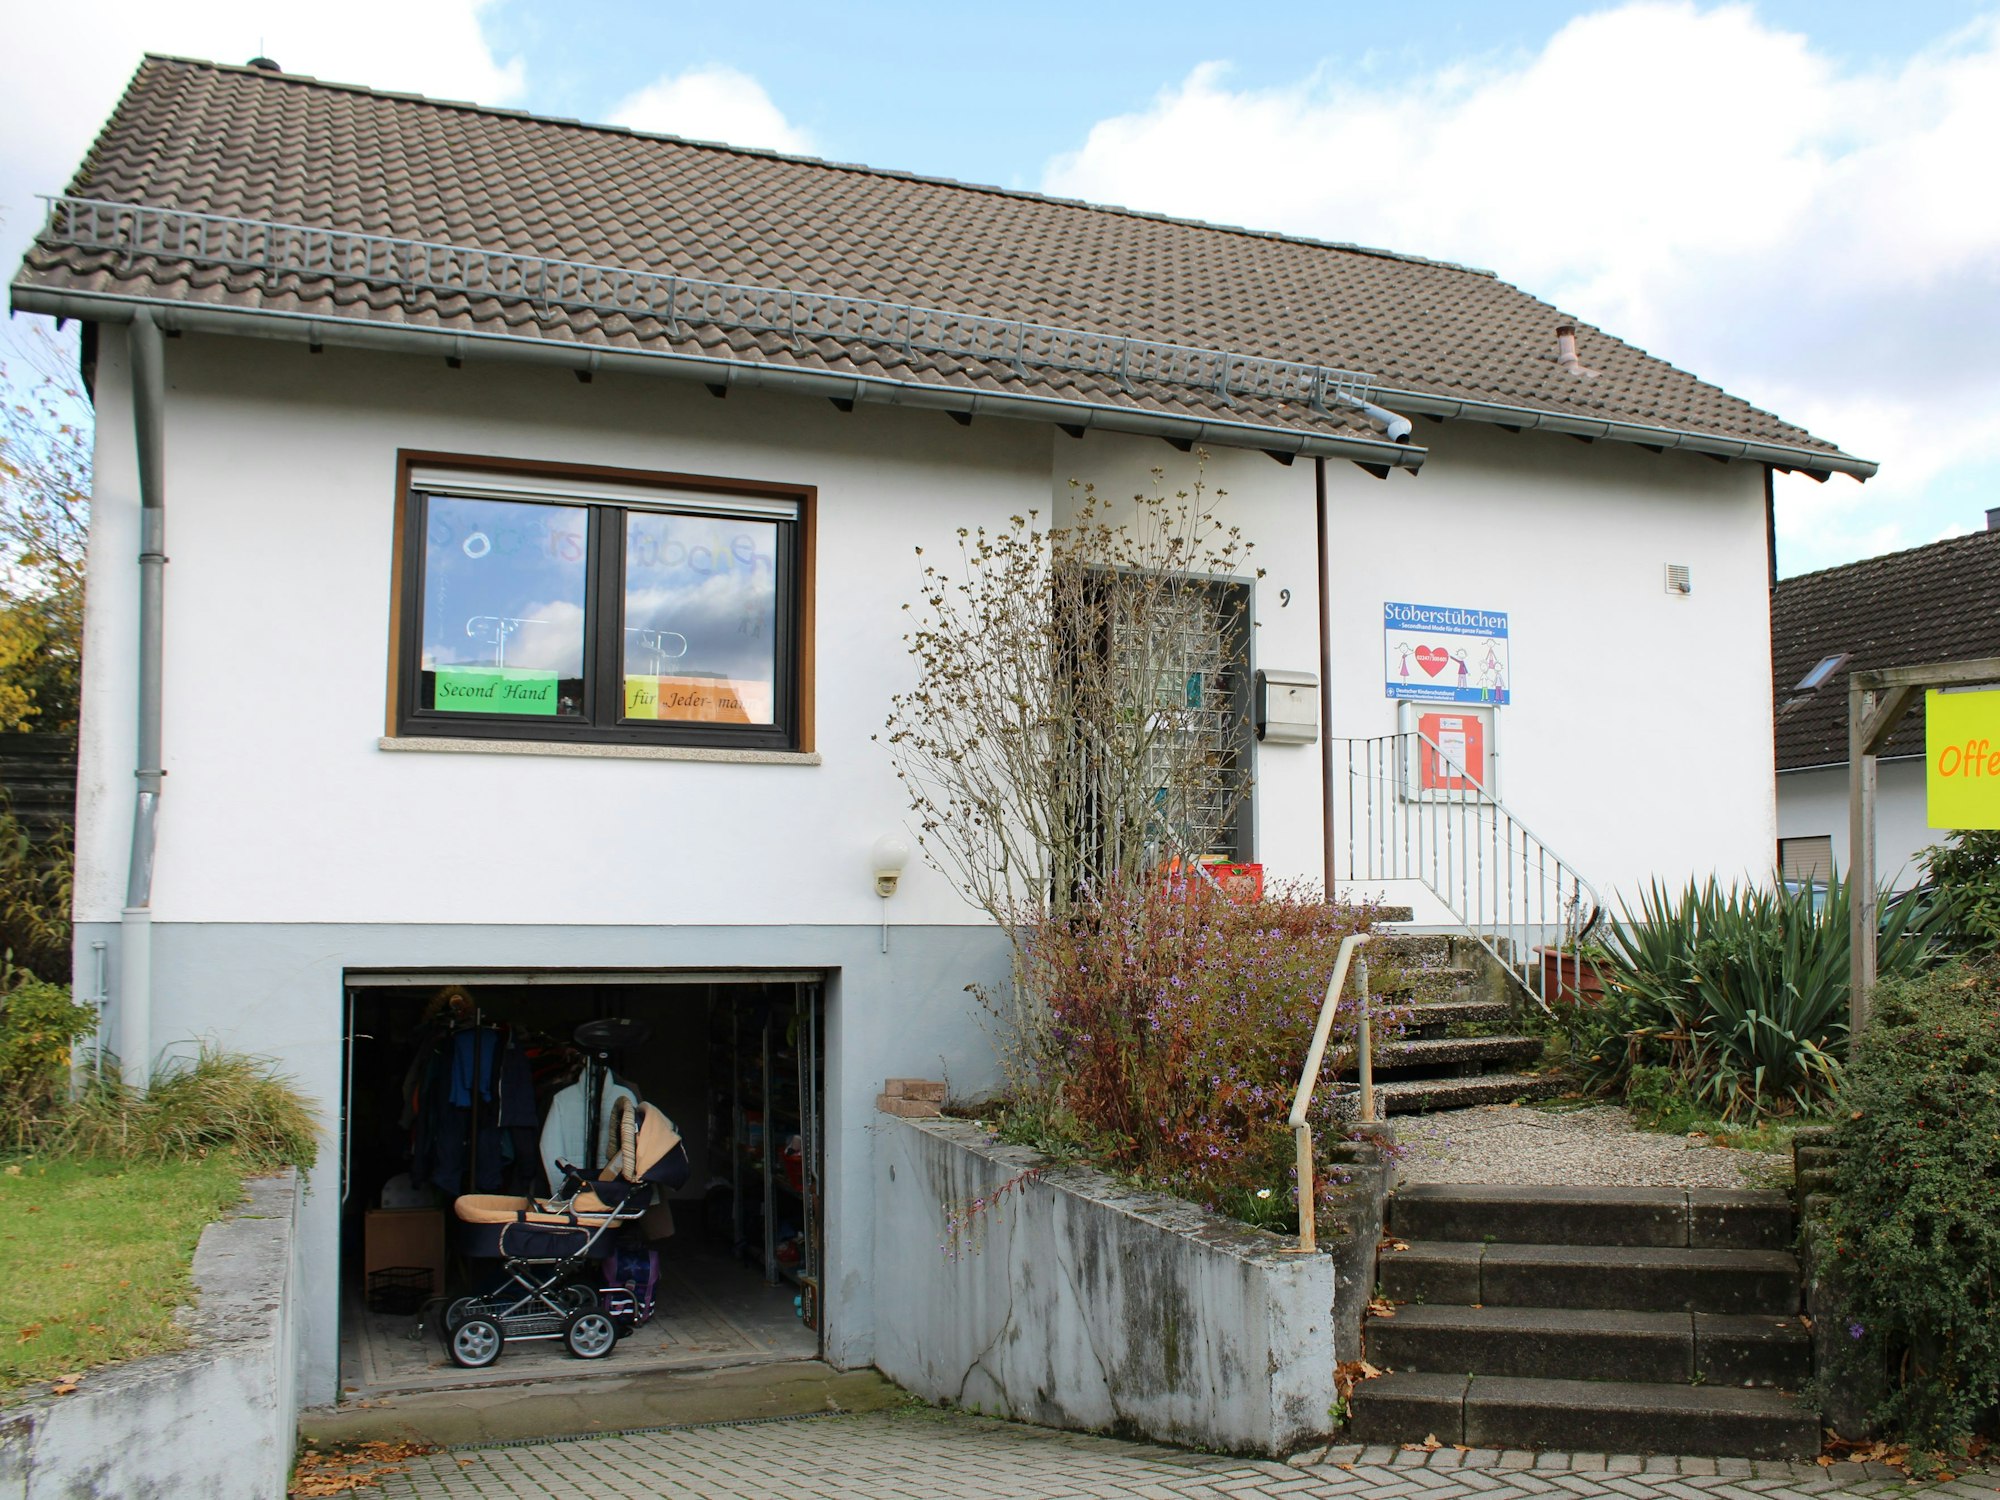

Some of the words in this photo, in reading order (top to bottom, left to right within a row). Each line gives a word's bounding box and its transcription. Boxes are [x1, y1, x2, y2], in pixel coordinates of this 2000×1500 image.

[1279, 588, 1291, 608] 9
[1385, 603, 1507, 629] Stöberstübchen
[1401, 621, 1430, 630] Secondhand
[1431, 624, 1446, 632] Mode
[1475, 628, 1493, 636] Familie
[439, 682, 498, 698] Second
[502, 685, 552, 700] Hand
[628, 689, 656, 709] für
[1938, 738, 2000, 777] Offe
